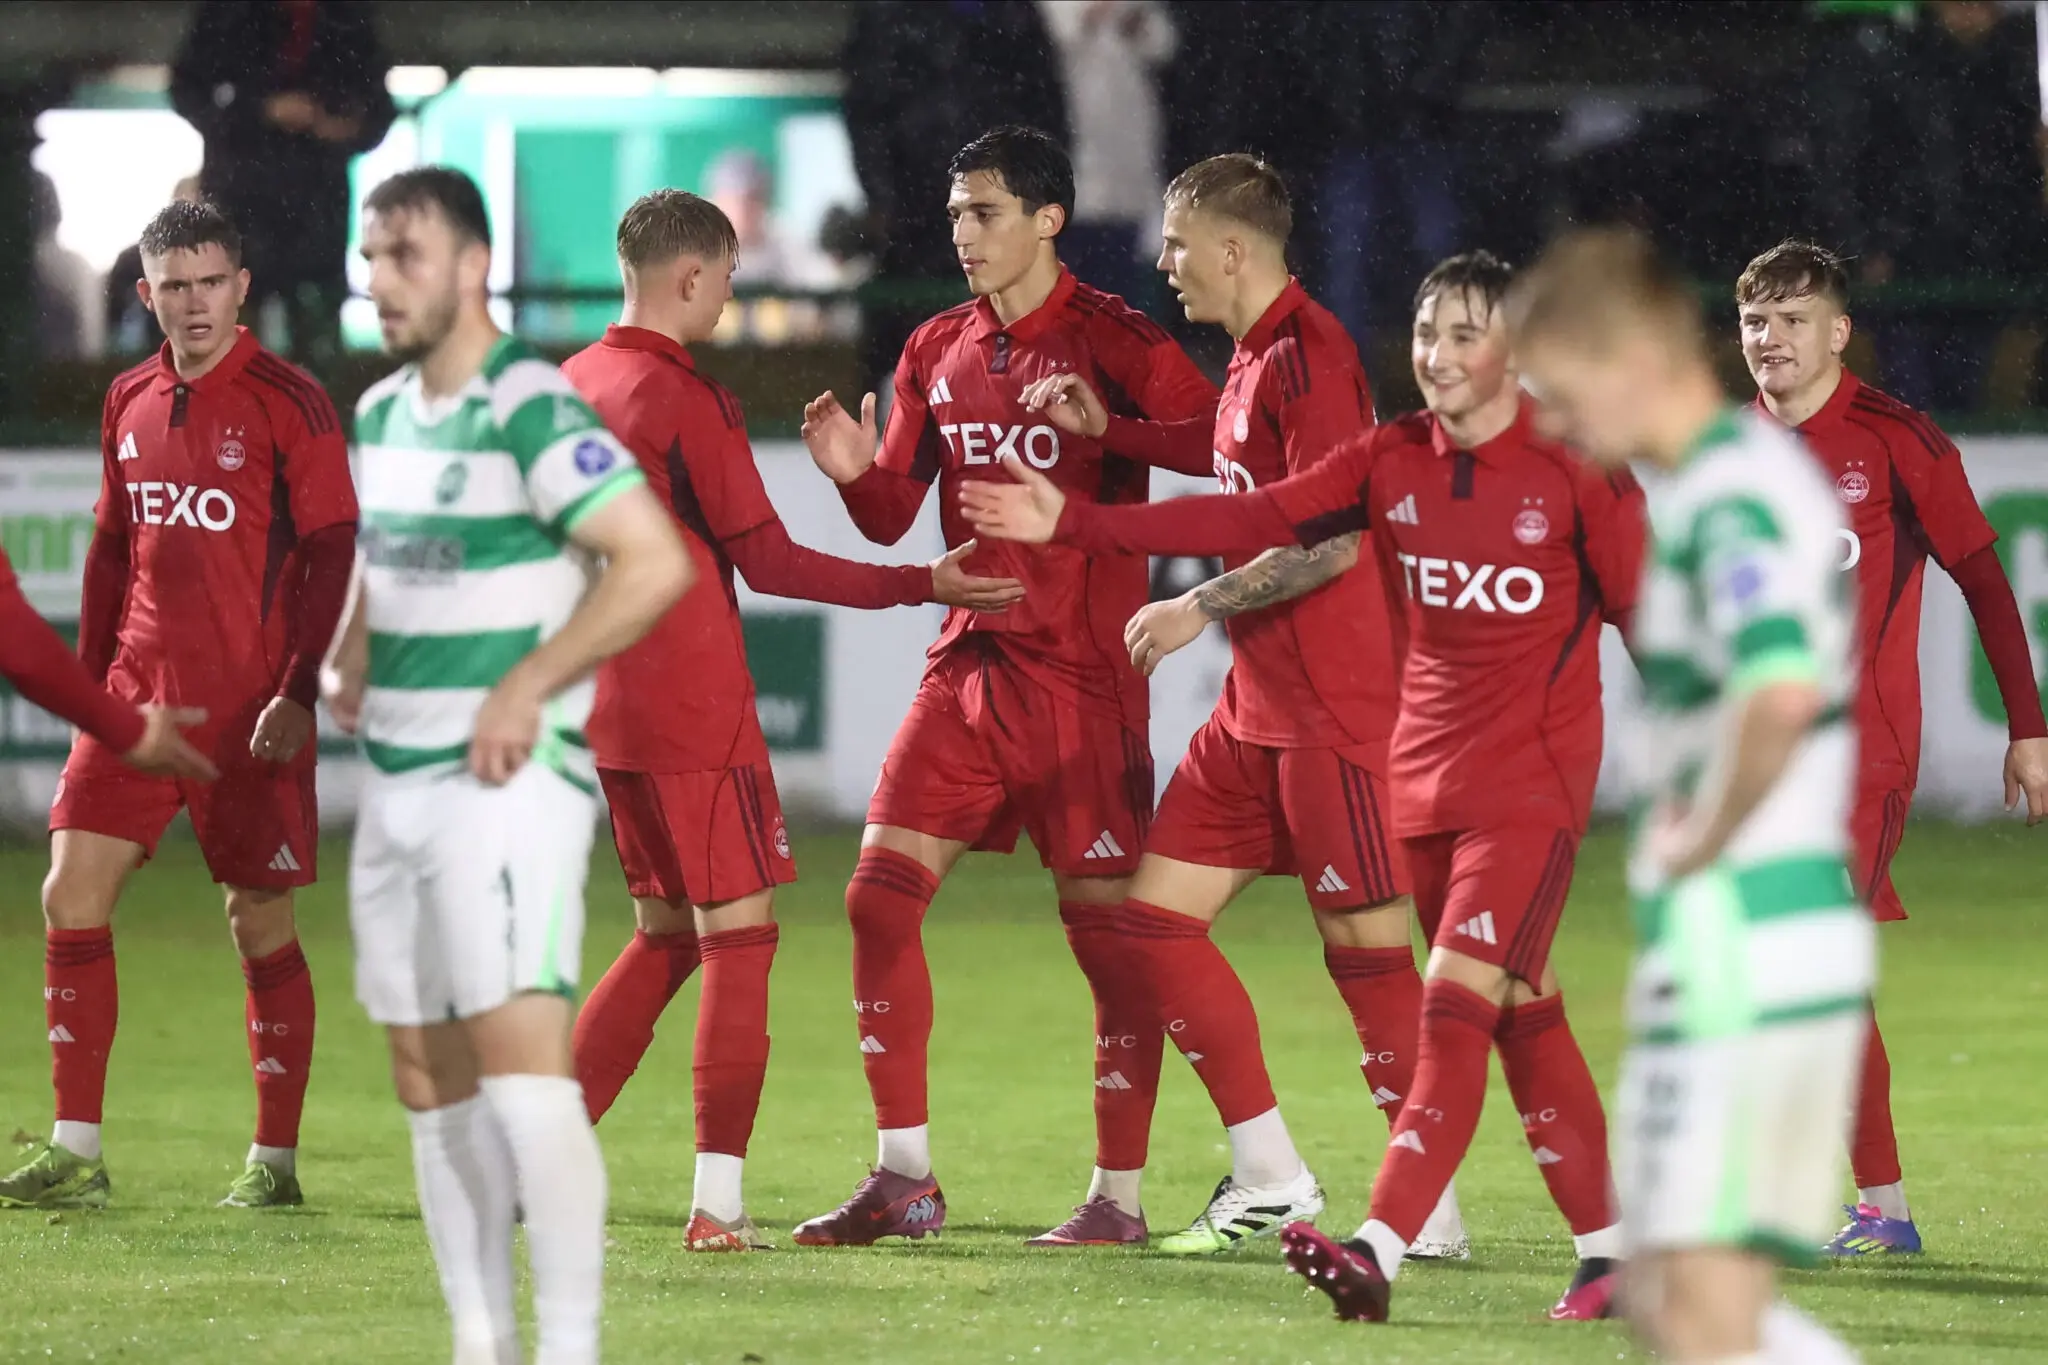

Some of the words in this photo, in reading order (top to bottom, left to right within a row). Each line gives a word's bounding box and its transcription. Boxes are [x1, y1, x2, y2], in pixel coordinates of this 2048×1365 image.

[940, 422, 1060, 470] TEXO
[126, 482, 236, 531] TEXO
[1397, 552, 1544, 615] TEXO
[1096, 1034, 1136, 1048] AFC
